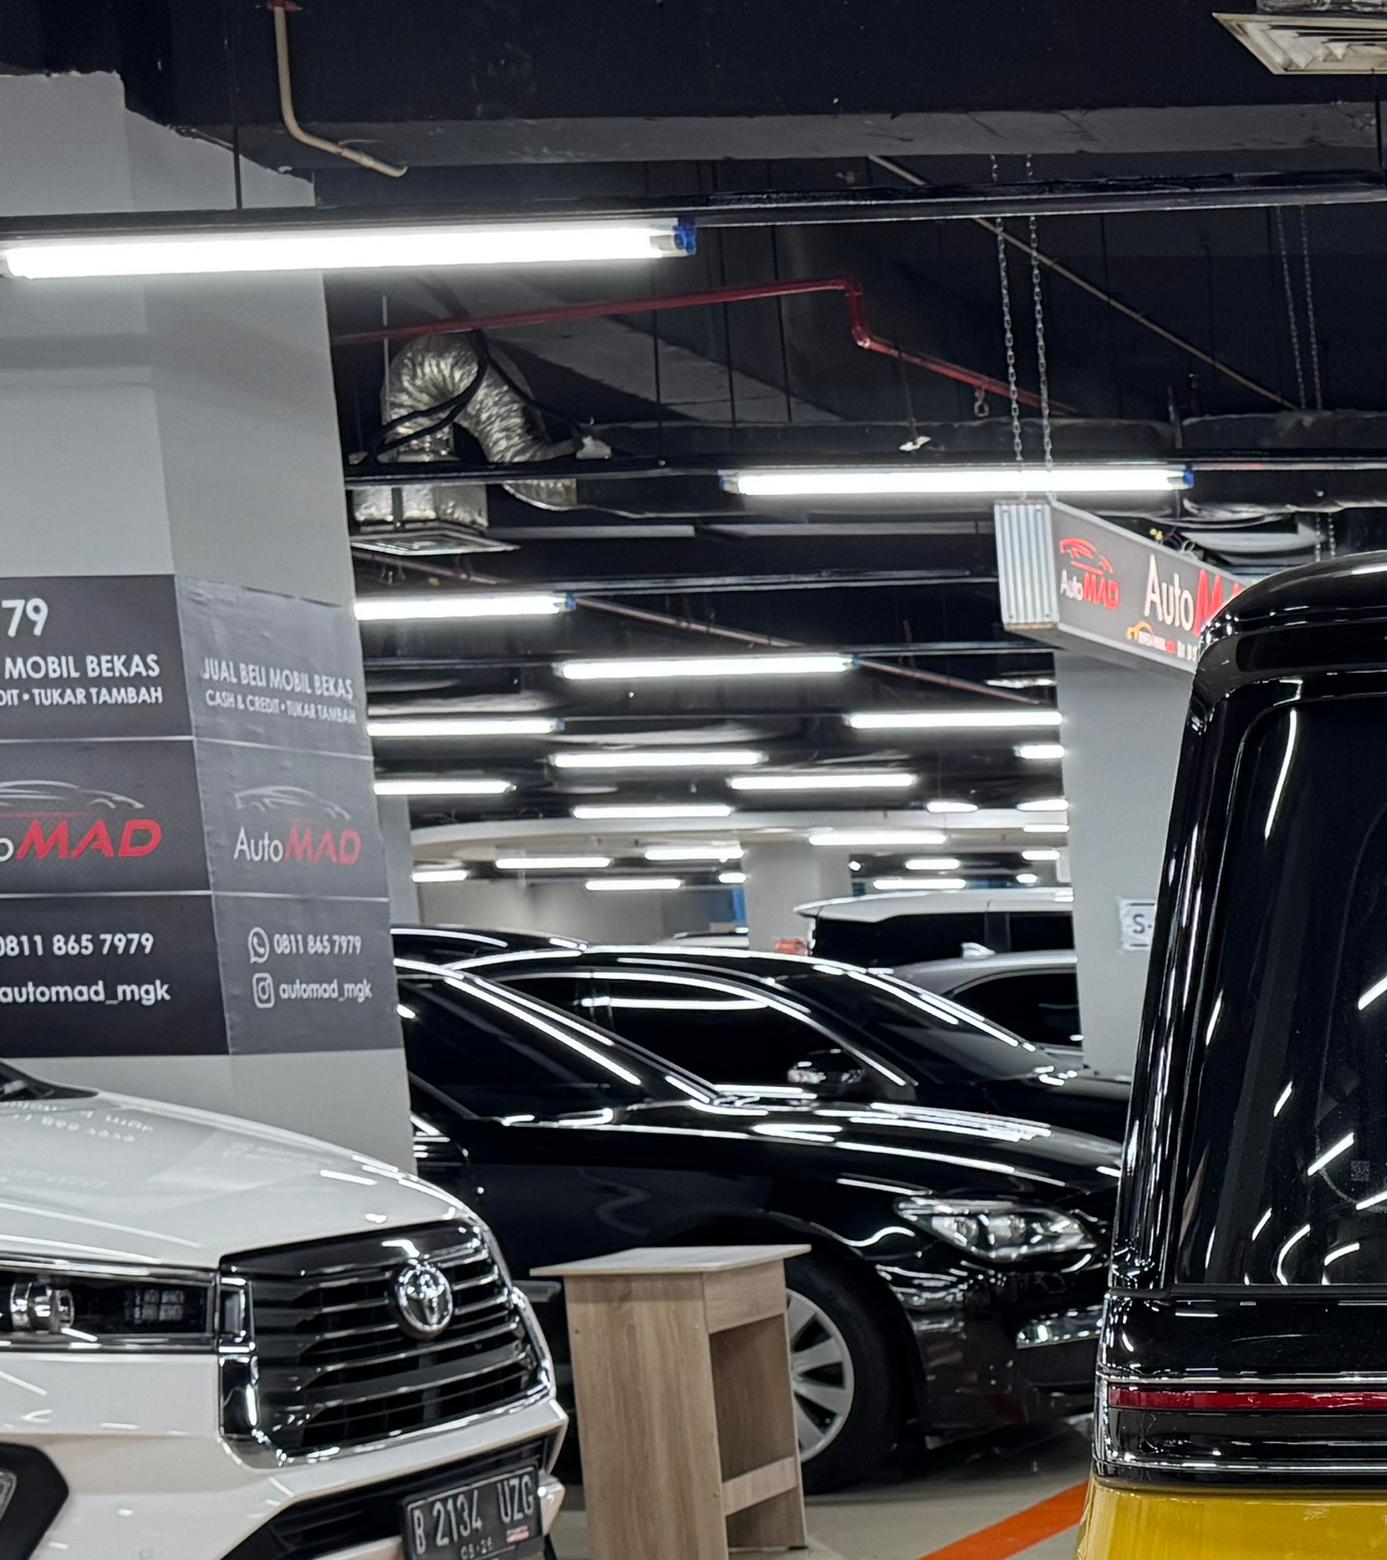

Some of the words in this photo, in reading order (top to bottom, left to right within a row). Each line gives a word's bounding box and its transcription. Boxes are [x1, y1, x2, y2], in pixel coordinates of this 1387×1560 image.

[1059, 568, 1121, 610] AutoMAD
[1143, 553, 1242, 637] AutoM
[1, 597, 49, 638] 79
[4, 654, 81, 680] MOBIL
[85, 653, 161, 679] BEKAS
[202, 657, 238, 684] JUAL
[239, 662, 267, 688] BELI
[269, 667, 313, 695] MOBIL
[313, 673, 354, 701] BEKAS
[32, 687, 87, 706] TUKAR
[90, 686, 164, 705] TAMBAH
[205, 689, 236, 709] CASH
[245, 694, 280, 715] CREDIT
[286, 699, 316, 720] TUKAR
[317, 703, 357, 725] TAMBAH
[233, 825, 363, 866] AutoMAD
[52, 934, 94, 956] 865
[99, 932, 154, 954] 7979
[273, 933, 304, 954] 0811
[307, 935, 331, 954] 865
[332, 935, 362, 955] 7979
[0, 979, 171, 1006] automad_mgk
[279, 979, 373, 1004] automad_mgk
[413, 1509, 426, 1555] B
[432, 1489, 483, 1548] 2134
[496, 1474, 535, 1525] UZG
